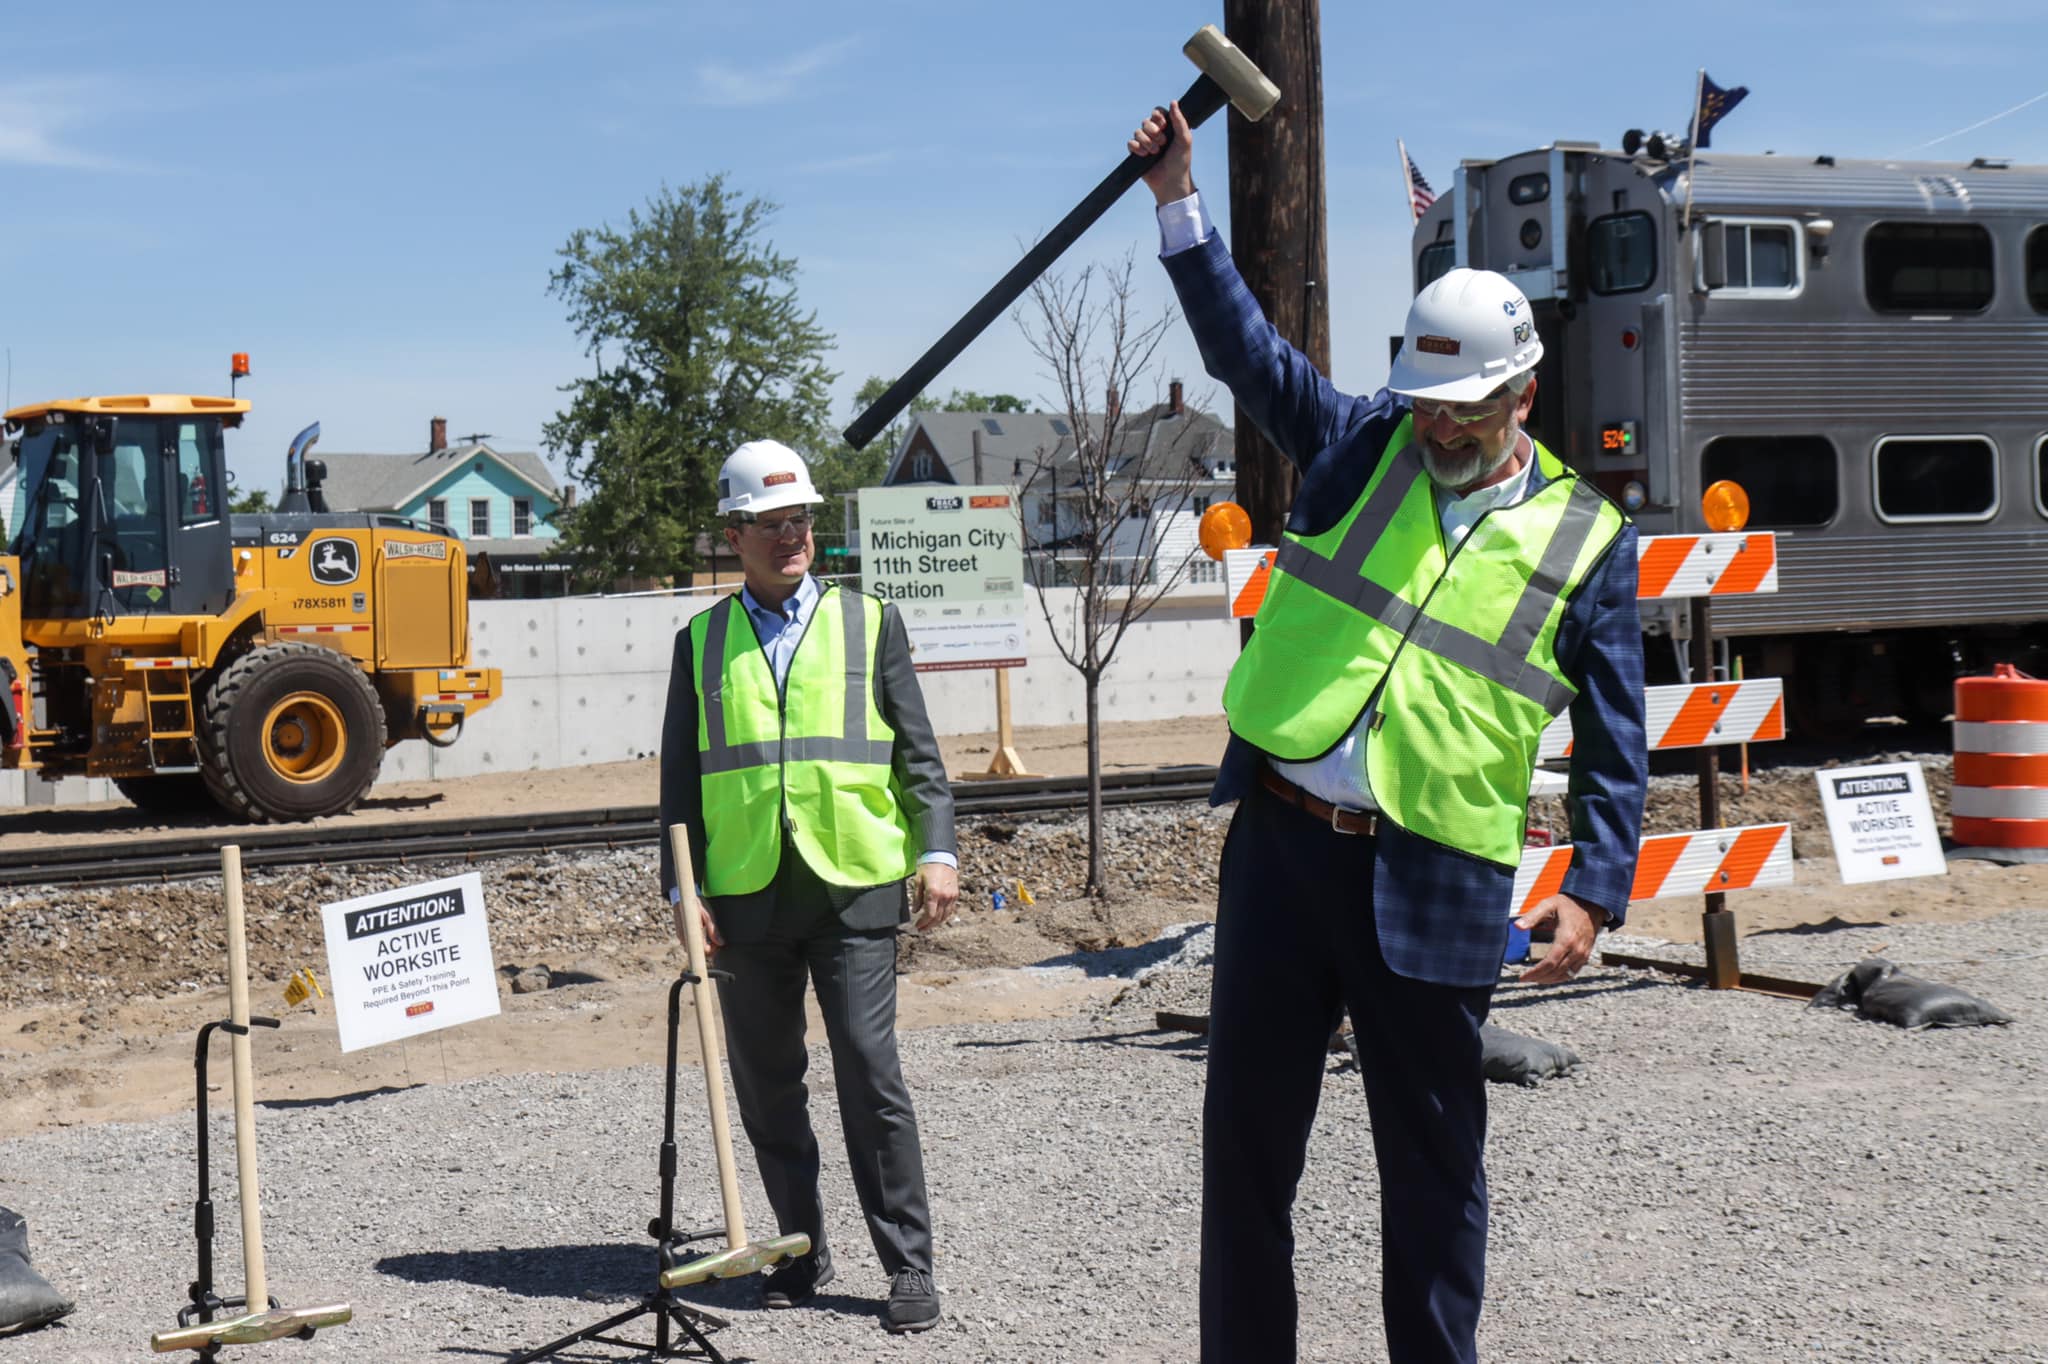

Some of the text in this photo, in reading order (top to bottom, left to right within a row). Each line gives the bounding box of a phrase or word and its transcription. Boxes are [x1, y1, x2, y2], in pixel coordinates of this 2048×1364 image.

[871, 518, 892, 526] Future
[270, 533, 298, 544] 624
[871, 528, 1006, 552] Michigan City
[873, 554, 978, 575] 11th Street
[873, 580, 944, 600] Station
[1840, 777, 1907, 795] ATTENTION:
[1857, 800, 1901, 816] ACTIVE
[1848, 815, 1915, 833] WORKSITE
[355, 896, 456, 933] ATTENTION:
[377, 927, 443, 957] ACTIVE
[363, 945, 461, 981] WORKSITE
[363, 977, 470, 1009] Required Beyond This Point
[372, 970, 456, 995] PPE & Safety Training
